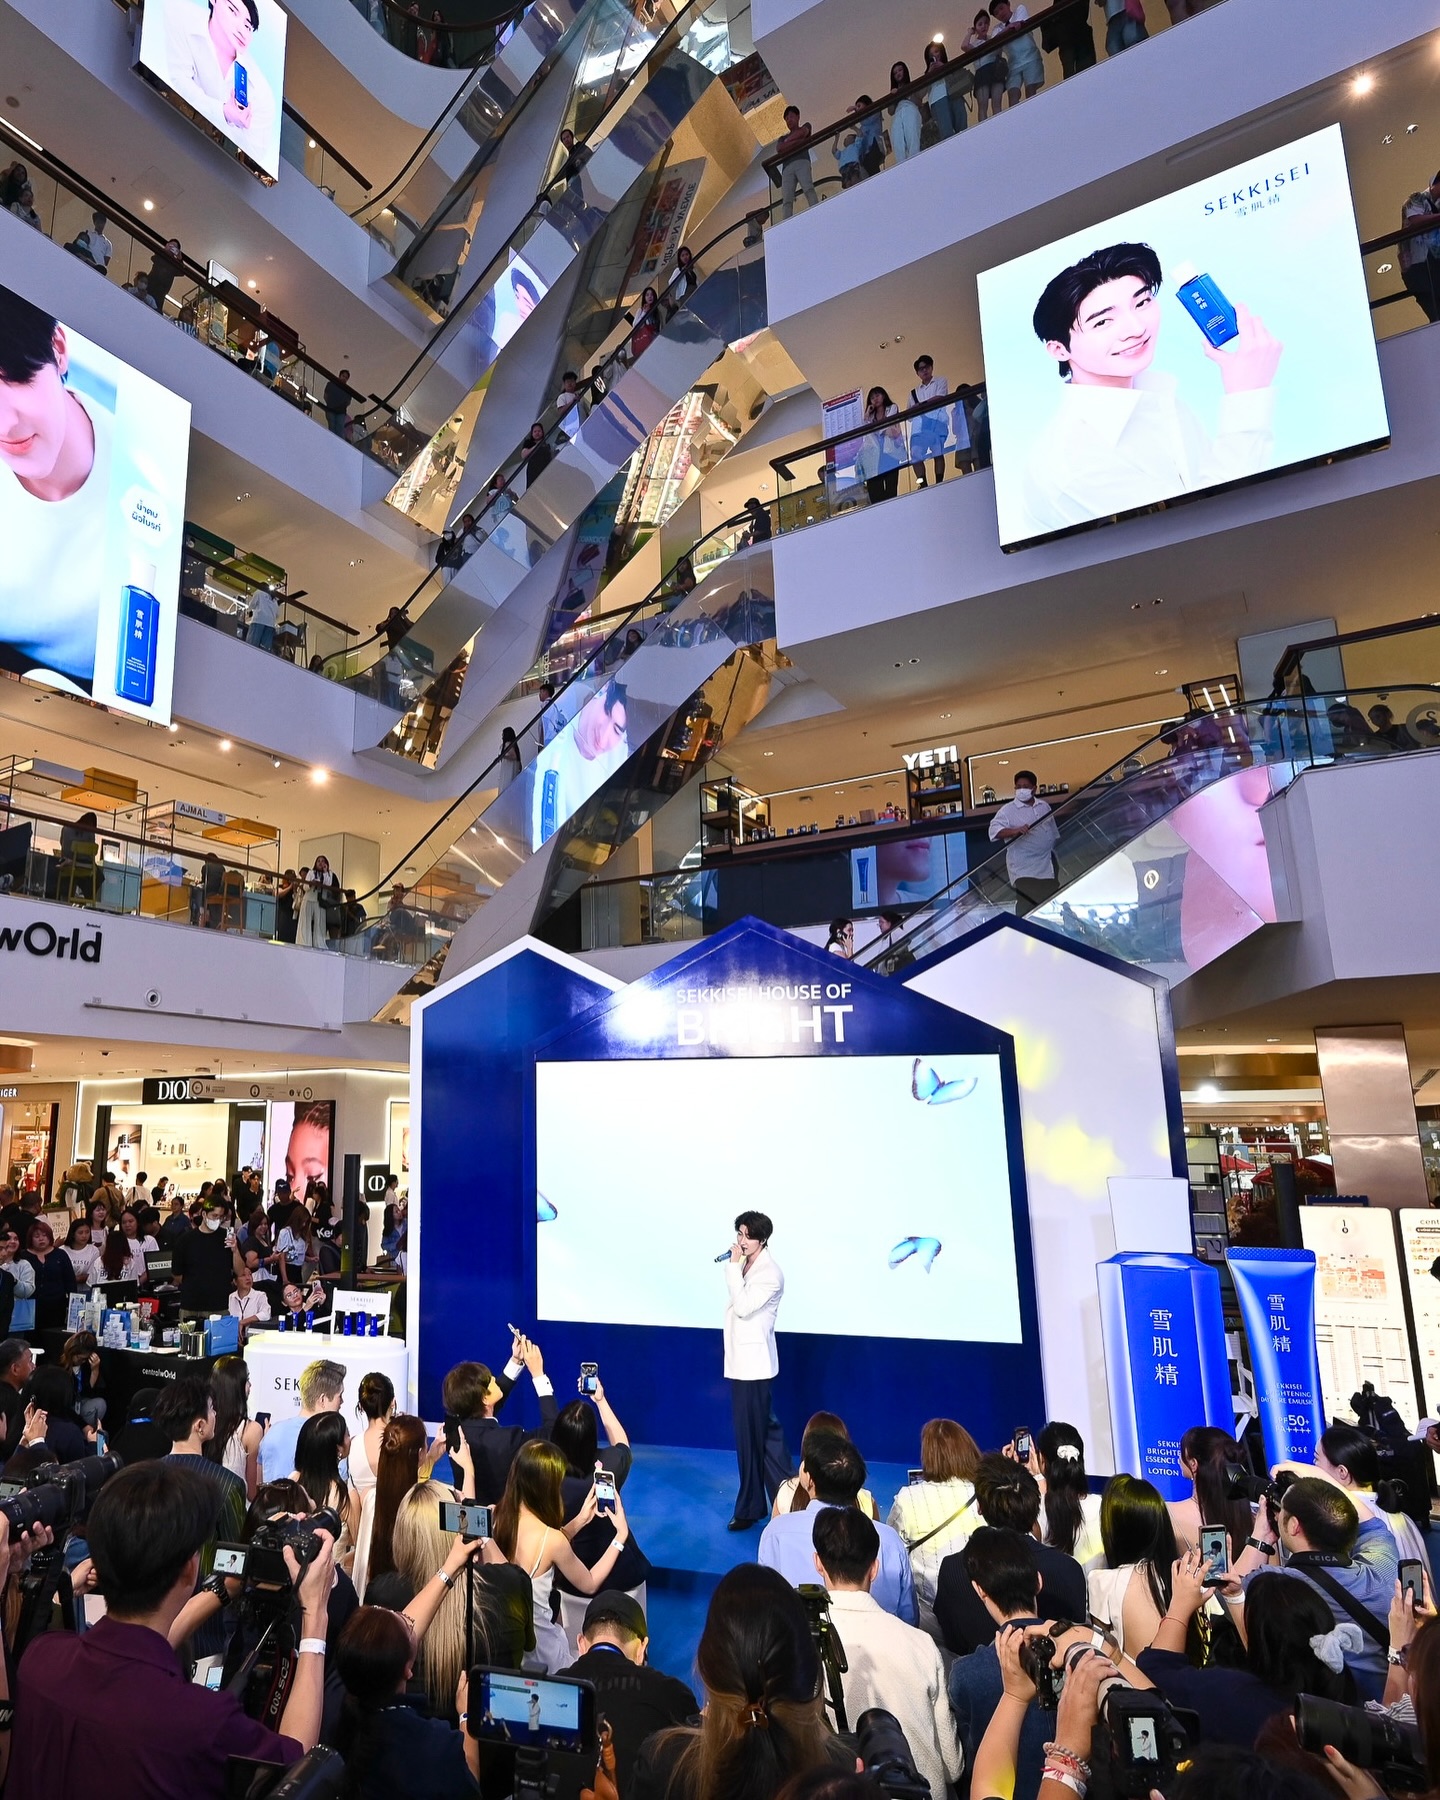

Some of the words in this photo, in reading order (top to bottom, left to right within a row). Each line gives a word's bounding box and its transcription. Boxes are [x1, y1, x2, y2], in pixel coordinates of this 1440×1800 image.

[1204, 163, 1309, 216] SEKKISEI
[902, 745, 958, 770] YETI
[180, 803, 207, 818] AJMAL
[677, 987, 752, 1004] SEKKISEI
[759, 984, 821, 1000] HOUSE
[826, 983, 852, 999] OF
[0, 1088, 17, 1098] IGER
[1267, 1294, 1291, 1353] 雪肌精
[1149, 1309, 1179, 1386] 雪肌精
[1274, 1382, 1302, 1390] EKKISEI
[1157, 1440, 1181, 1449] SEKKI
[1285, 1445, 1308, 1454] KOSÉ
[1145, 1456, 1176, 1465] ESSENCE
[1148, 1467, 1179, 1476] LOTION
[278, 1657, 290, 1689] EOS
[270, 1690, 282, 1715] 80D
